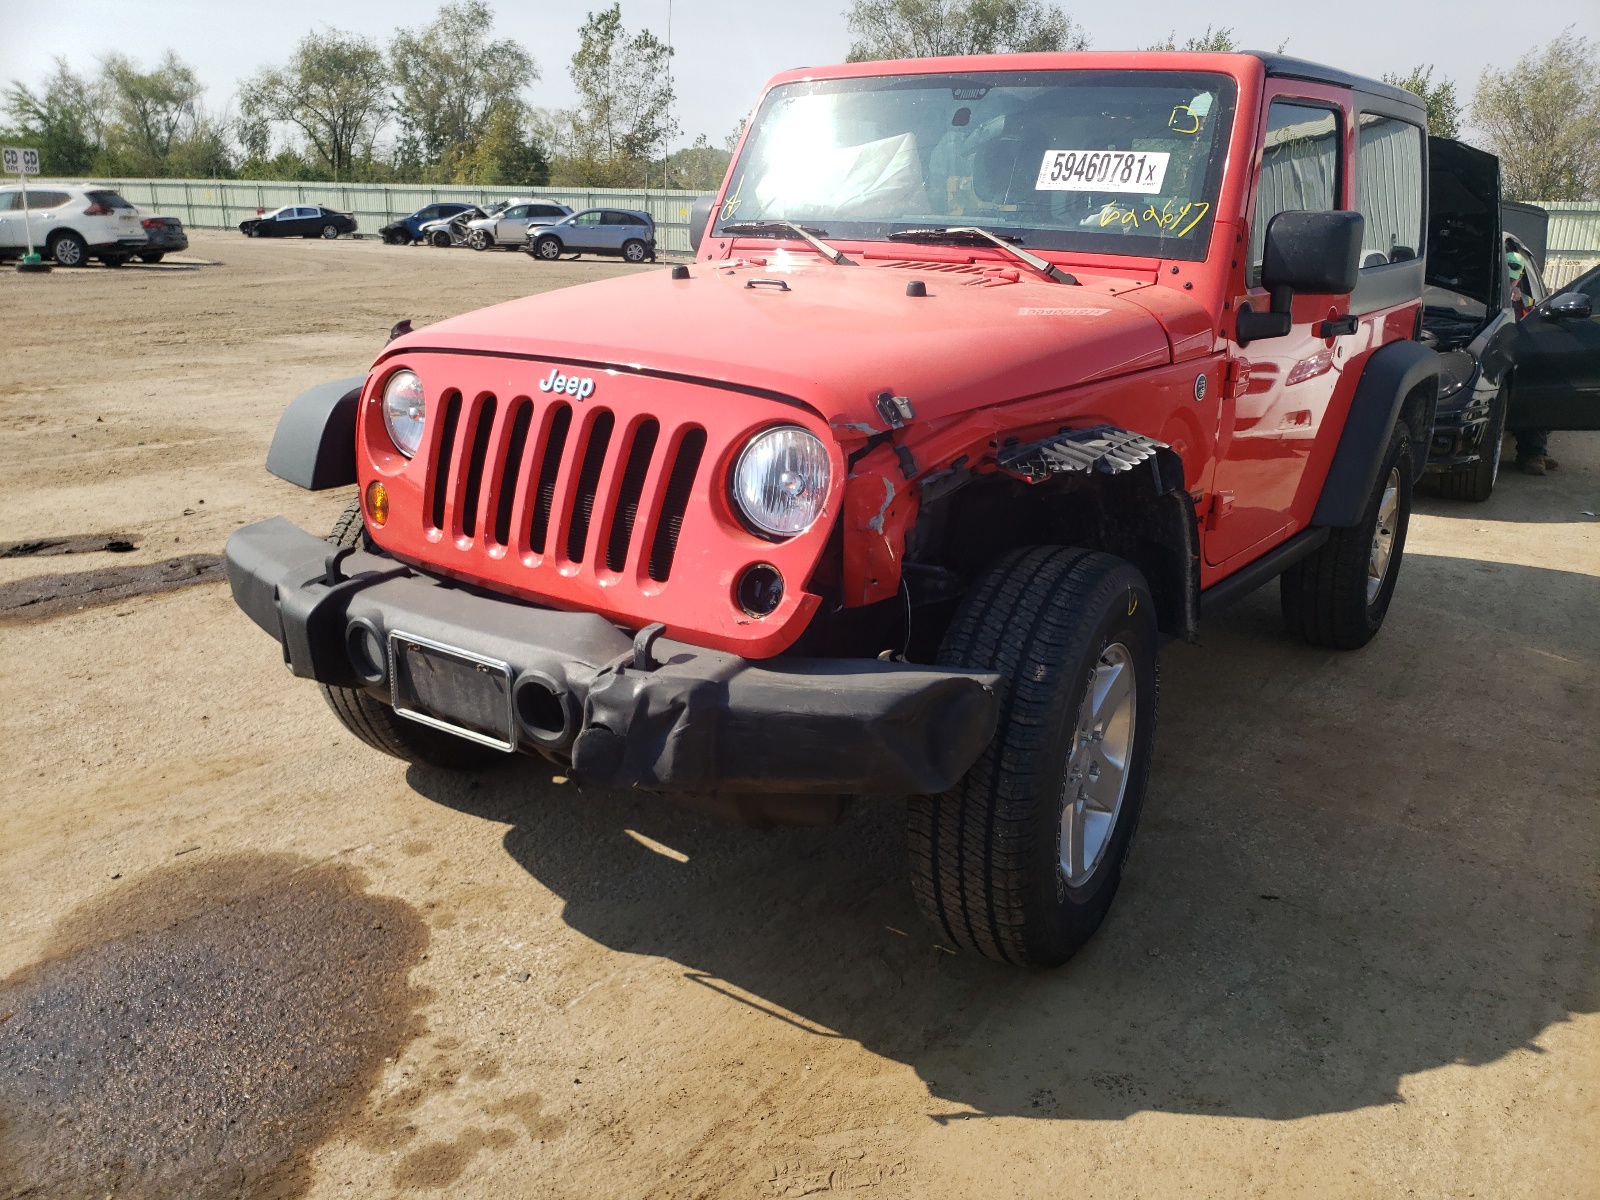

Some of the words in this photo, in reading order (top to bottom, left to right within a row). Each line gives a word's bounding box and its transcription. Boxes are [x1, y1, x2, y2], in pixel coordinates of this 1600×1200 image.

[4, 150, 18, 164] CD
[23, 151, 37, 165] CD
[539, 368, 596, 402] Jeep
